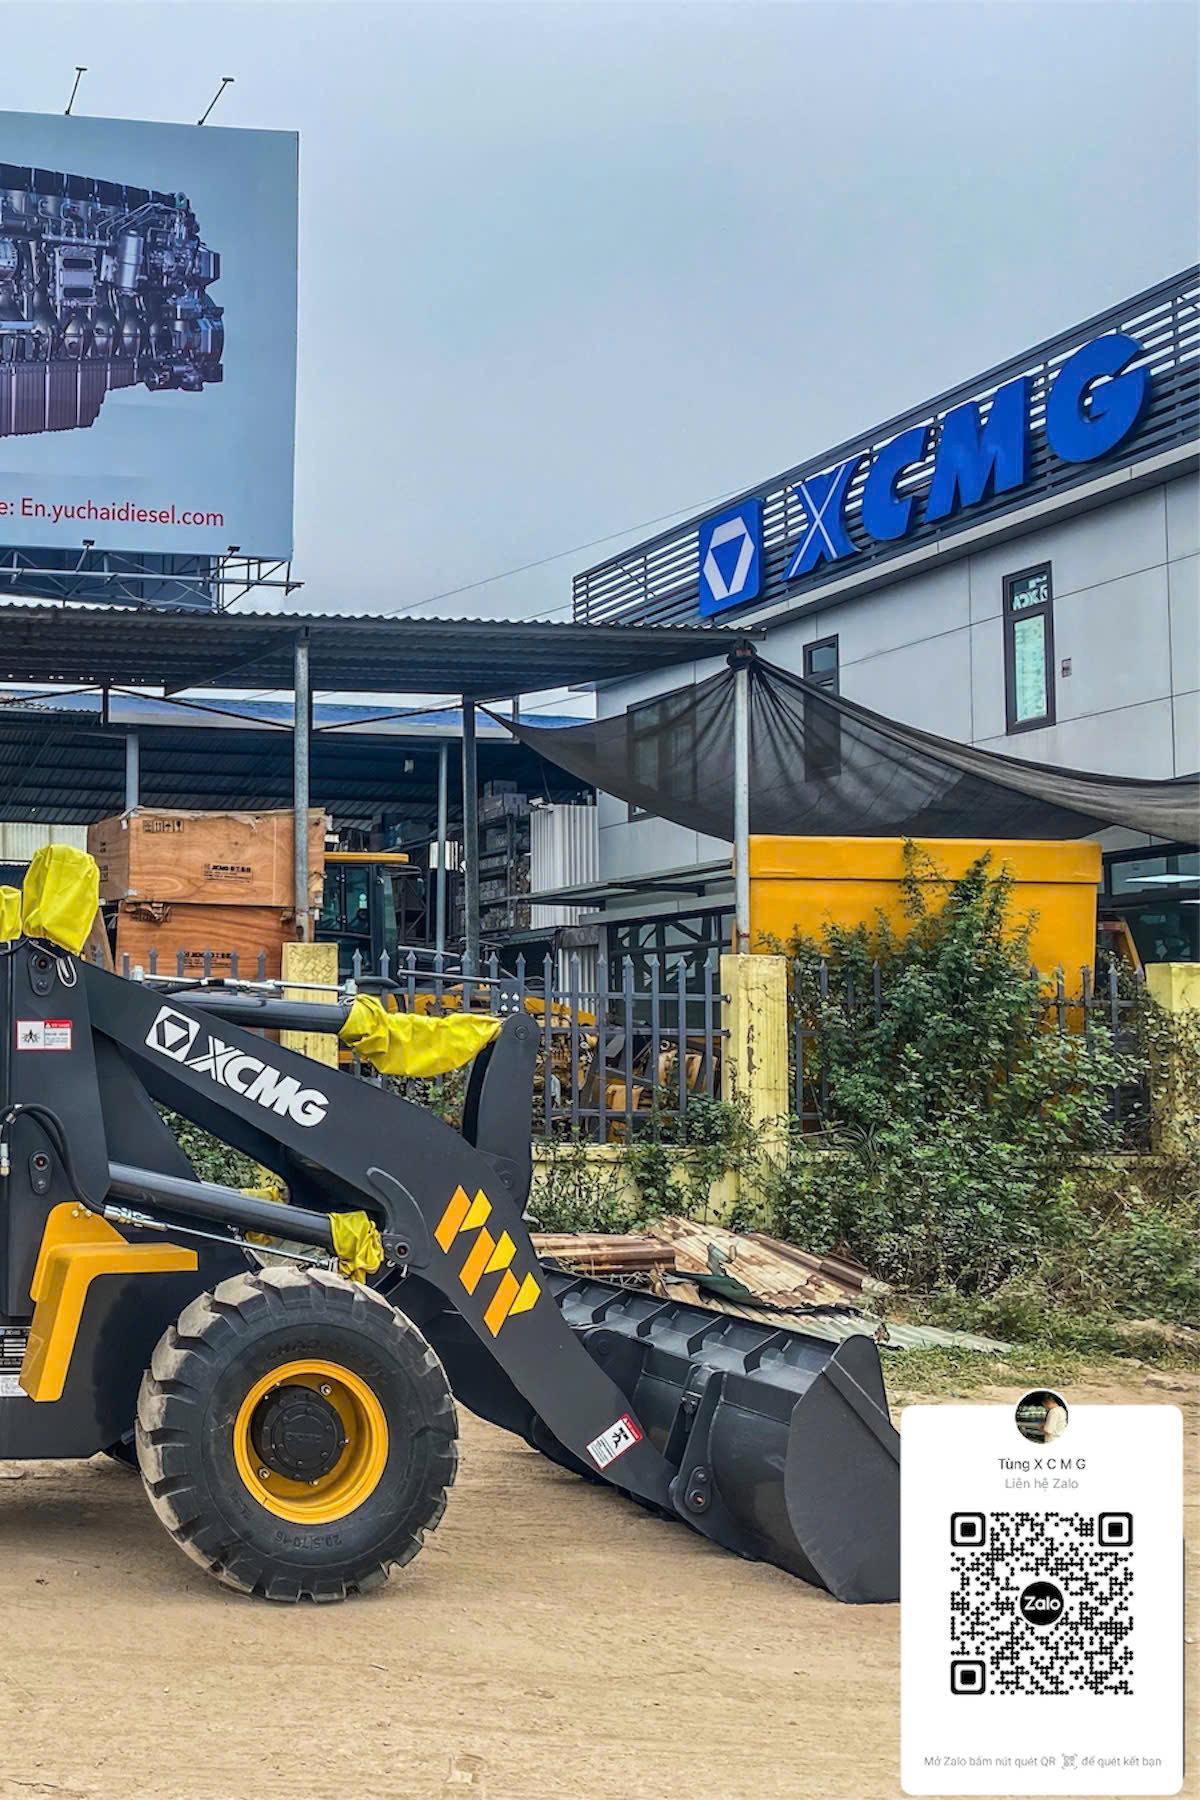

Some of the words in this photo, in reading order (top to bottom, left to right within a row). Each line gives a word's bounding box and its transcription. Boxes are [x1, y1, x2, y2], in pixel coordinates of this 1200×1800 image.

[781, 332, 1152, 582] XCMG
[20, 498, 225, 528] En.yuchaidiesel.com
[183, 1034, 330, 1129] XCMG
